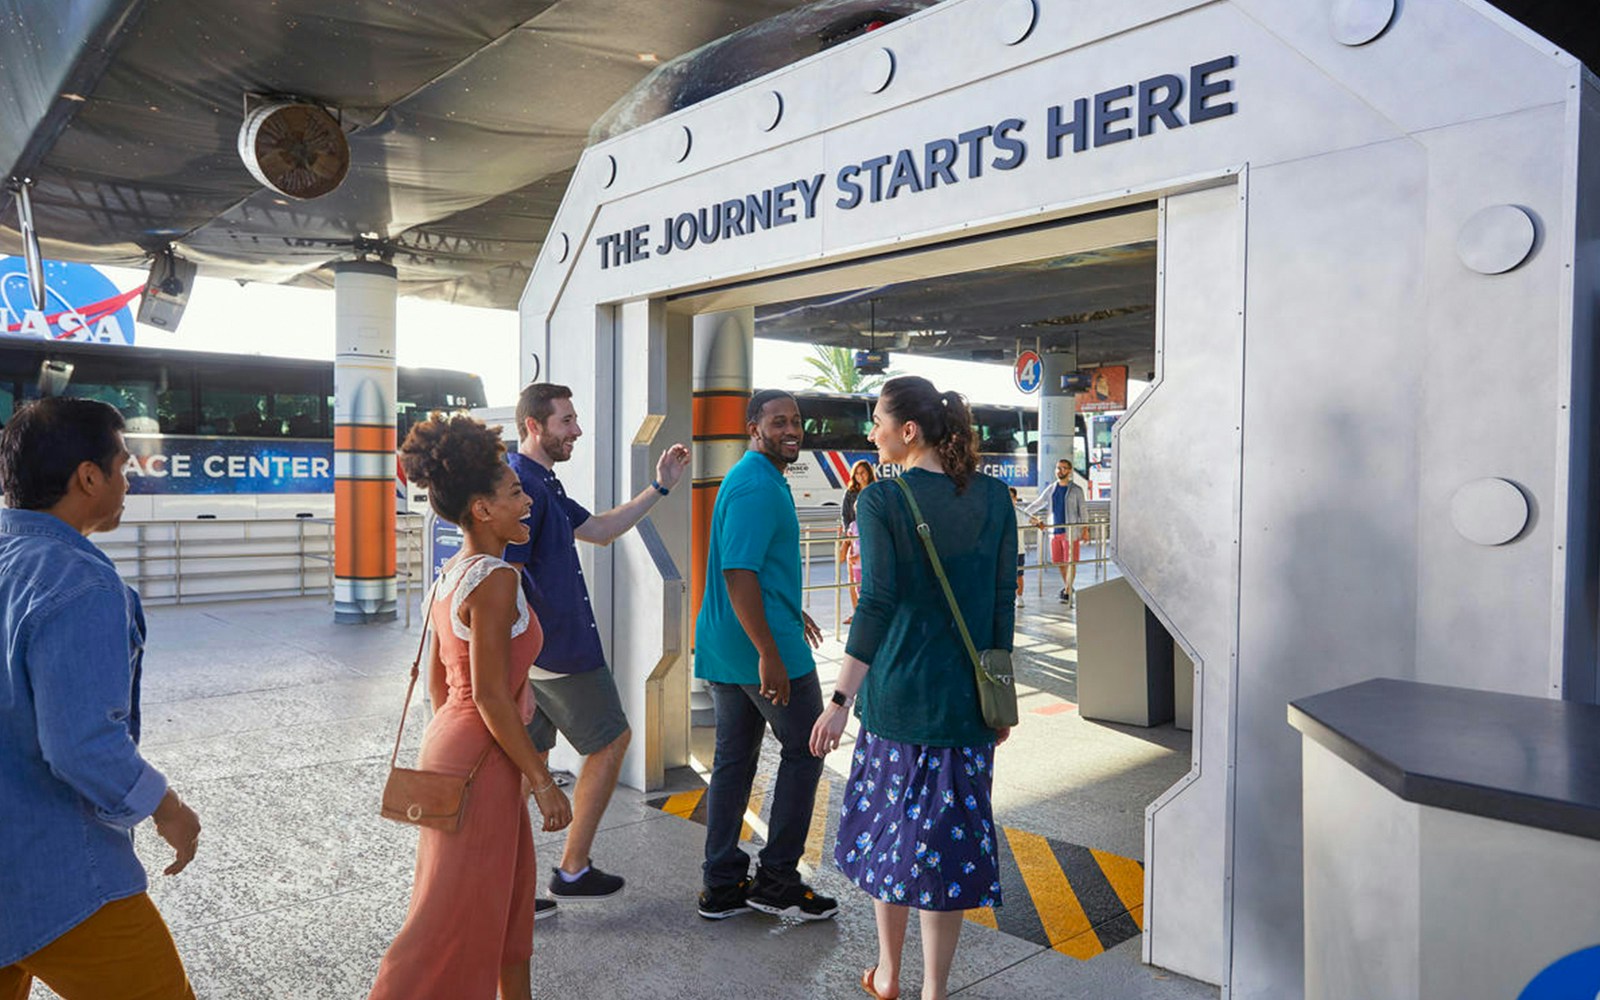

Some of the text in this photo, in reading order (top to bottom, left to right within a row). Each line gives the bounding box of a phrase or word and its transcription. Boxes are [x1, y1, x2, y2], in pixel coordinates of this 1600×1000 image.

[597, 56, 1237, 269] THE JOURNEY STARTS HERE
[1021, 359, 1036, 385] 4
[124, 454, 330, 478] ACE CENTER
[873, 463, 907, 478] KEN
[983, 463, 1029, 478] CENTER
